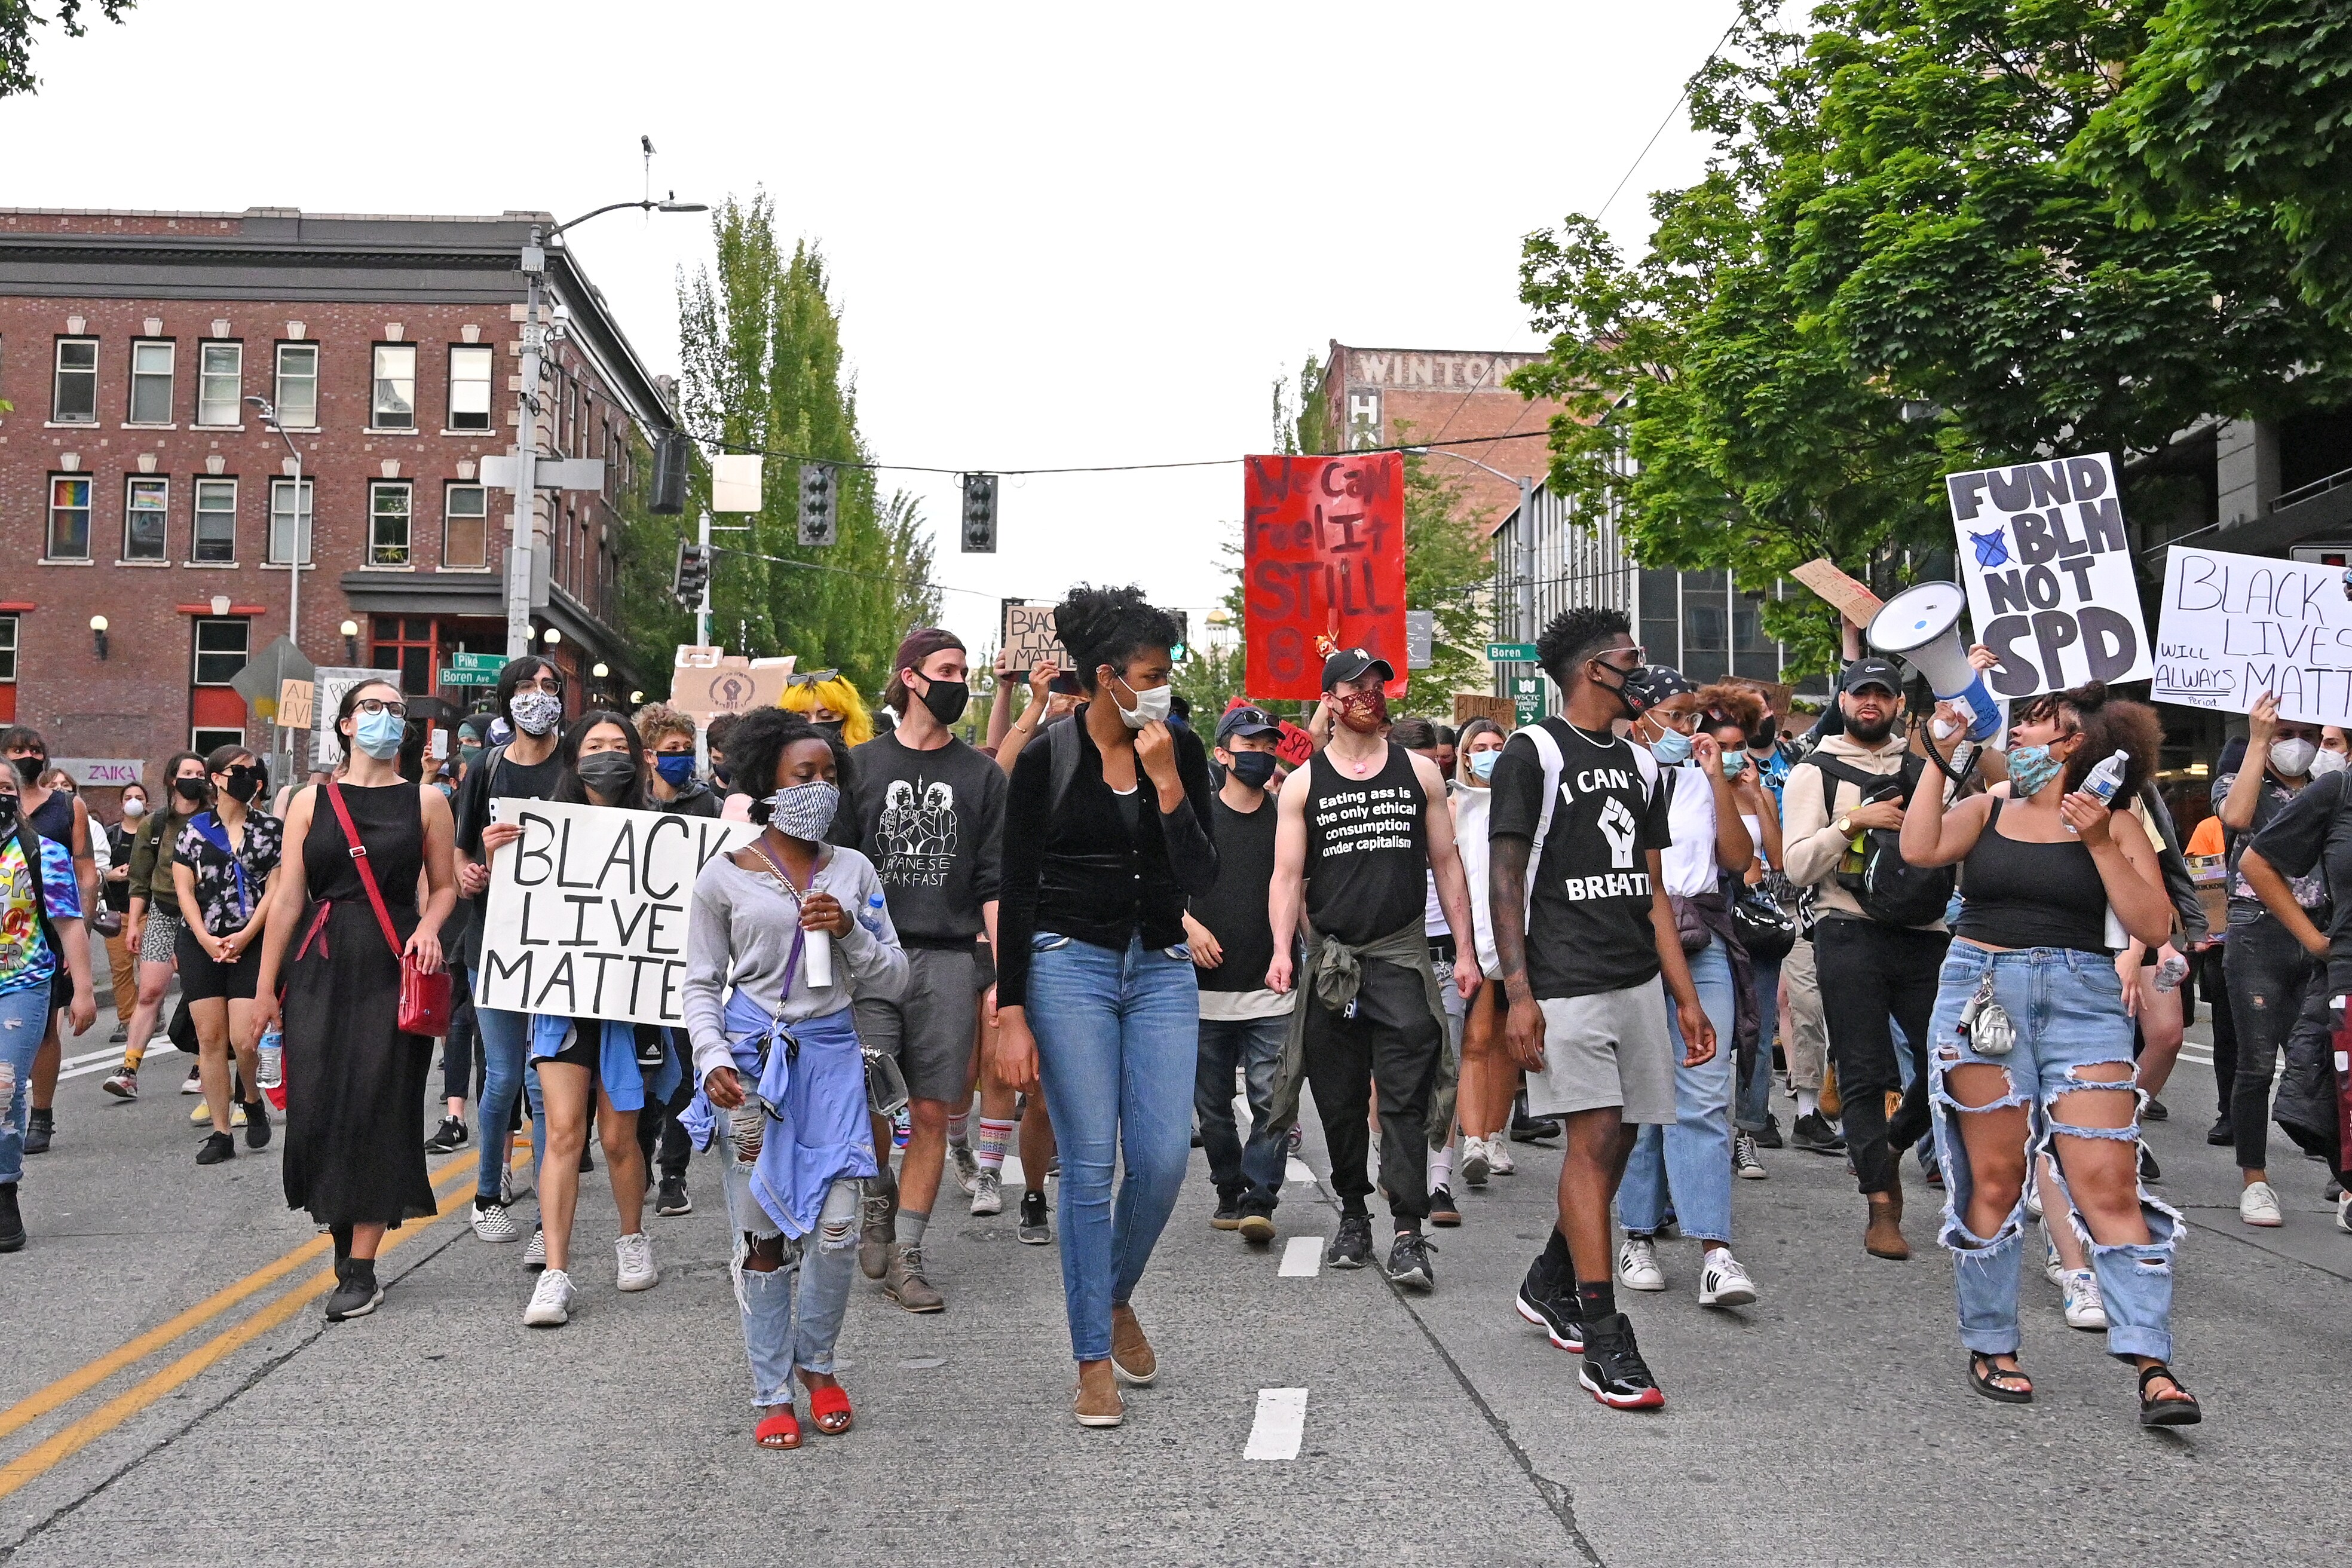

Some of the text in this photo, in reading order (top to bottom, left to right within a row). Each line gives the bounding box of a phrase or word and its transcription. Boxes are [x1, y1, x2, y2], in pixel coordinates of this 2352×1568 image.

[1359, 354, 1554, 385] WINTON
[1949, 458, 2106, 520] FUND
[2011, 498, 2126, 565] BLM
[1250, 558, 1395, 619] STILL
[1984, 556, 2094, 615] NOT
[2178, 556, 2327, 625] BLACK
[1012, 610, 1056, 635] BLAC
[1021, 633, 1061, 650] LIV
[1492, 647, 1521, 657] Boren
[1983, 607, 2136, 696] SPD
[2161, 643, 2209, 660] WILL
[458, 655, 478, 668] Pike
[443, 670, 473, 682] Boren
[2155, 664, 2236, 690] ALWAYS
[1284, 732, 1314, 760] SPD
[1319, 786, 1411, 809] Eating ass is
[1560, 782, 1574, 805] I
[1316, 801, 1416, 826] the only ethical
[1325, 818, 1410, 840] consumption
[514, 811, 731, 900] BLACK
[1322, 835, 1411, 857] under capitalism
[875, 855, 950, 872] JAPANESE
[877, 871, 948, 887] BEAKFAST
[520, 892, 683, 954] LIVE
[482, 950, 687, 1019] MATTE
